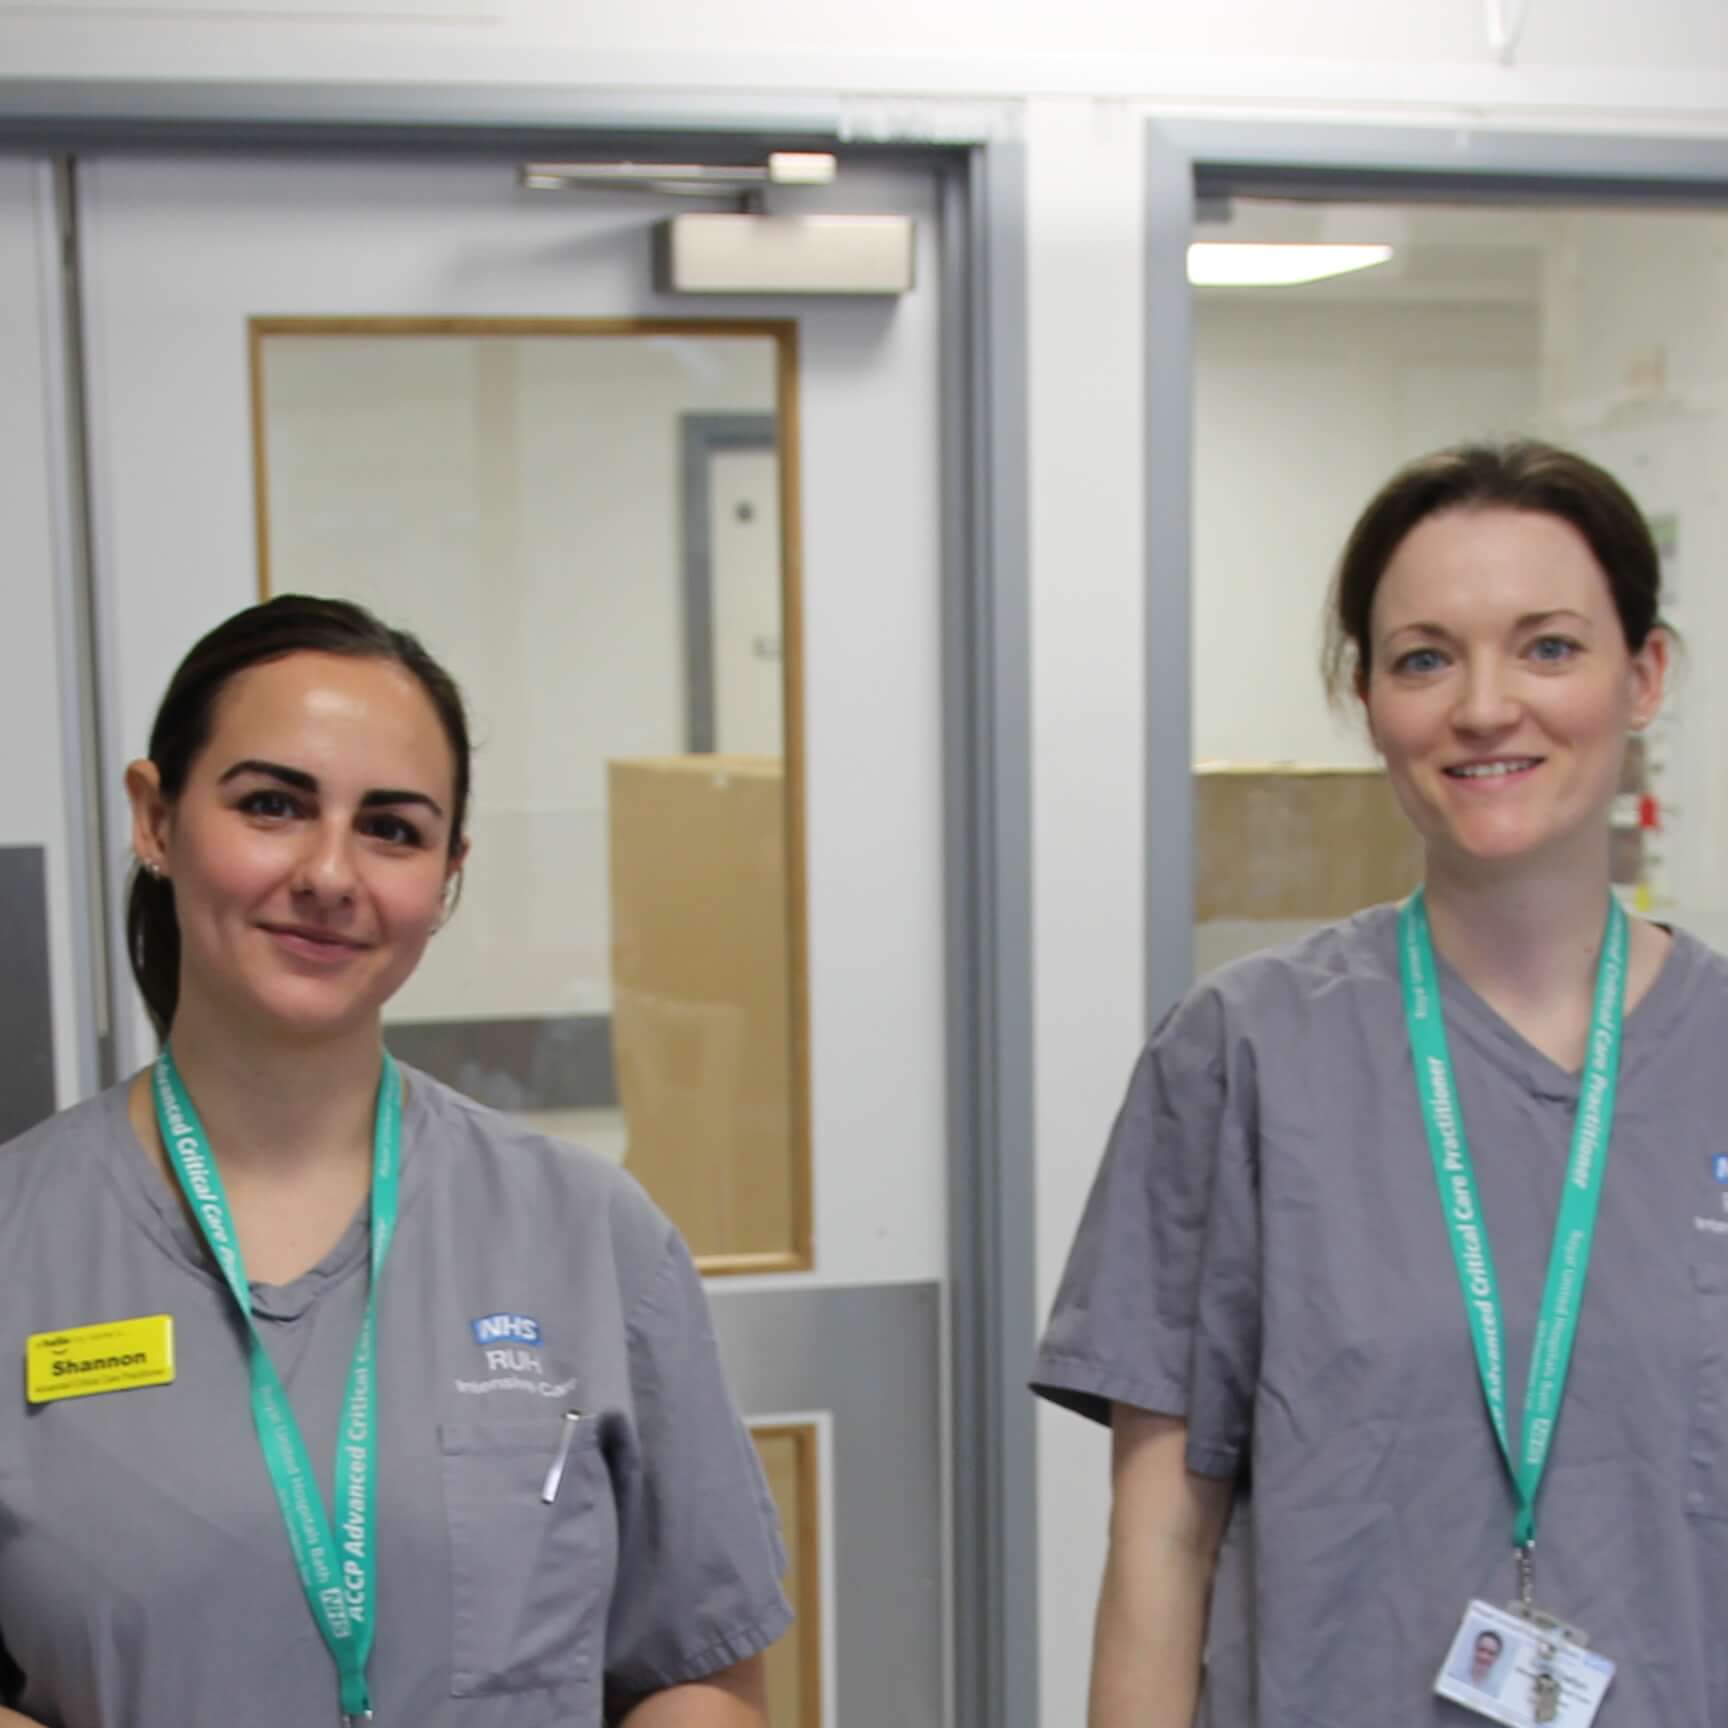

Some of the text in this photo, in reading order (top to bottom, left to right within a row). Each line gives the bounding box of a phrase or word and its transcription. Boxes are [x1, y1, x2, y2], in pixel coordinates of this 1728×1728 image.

[1592, 1029, 1613, 1071] Care
[1427, 1055, 1464, 1172] Practitioner
[1572, 1072, 1608, 1190] Practitioner
[176, 1137, 219, 1202] Critical
[200, 1203, 229, 1243] Care
[1451, 1175, 1474, 1220] Care
[1455, 1223, 1490, 1297] Critical
[52, 1352, 148, 1376] Shannon
[479, 1315, 537, 1341] NHS
[485, 1350, 543, 1374] RUH
[347, 1368, 369, 1441] Critical
[291, 1477, 320, 1544] Hospitals
[310, 1546, 330, 1583] Bath
[343, 1446, 368, 1557] Advanced
[343, 1560, 365, 1622] ACCP
